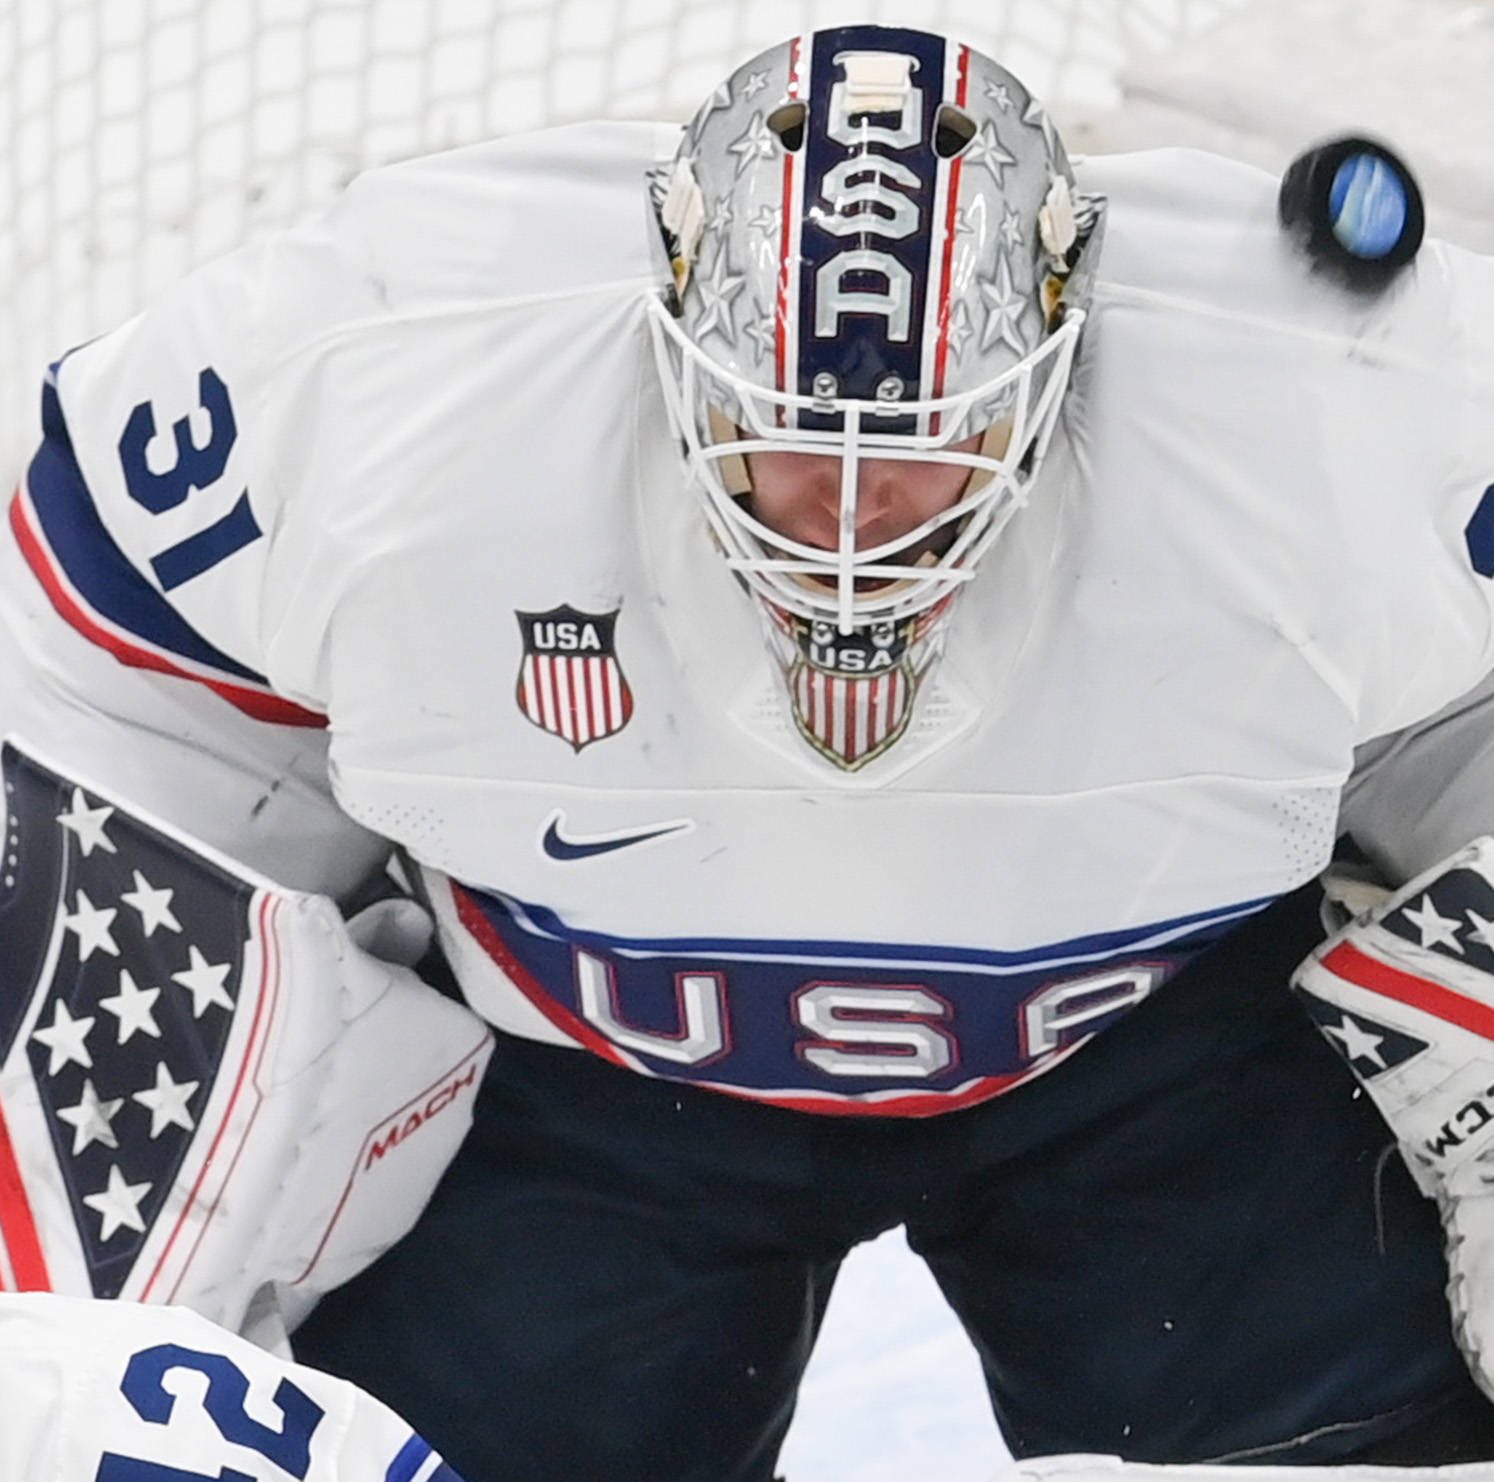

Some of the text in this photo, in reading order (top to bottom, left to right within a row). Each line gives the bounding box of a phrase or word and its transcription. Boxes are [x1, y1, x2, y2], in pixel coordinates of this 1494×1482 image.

[118, 366, 263, 593] 31
[533, 621, 601, 650] USA
[809, 643, 893, 671] USA
[363, 1063, 478, 1172] MACH
